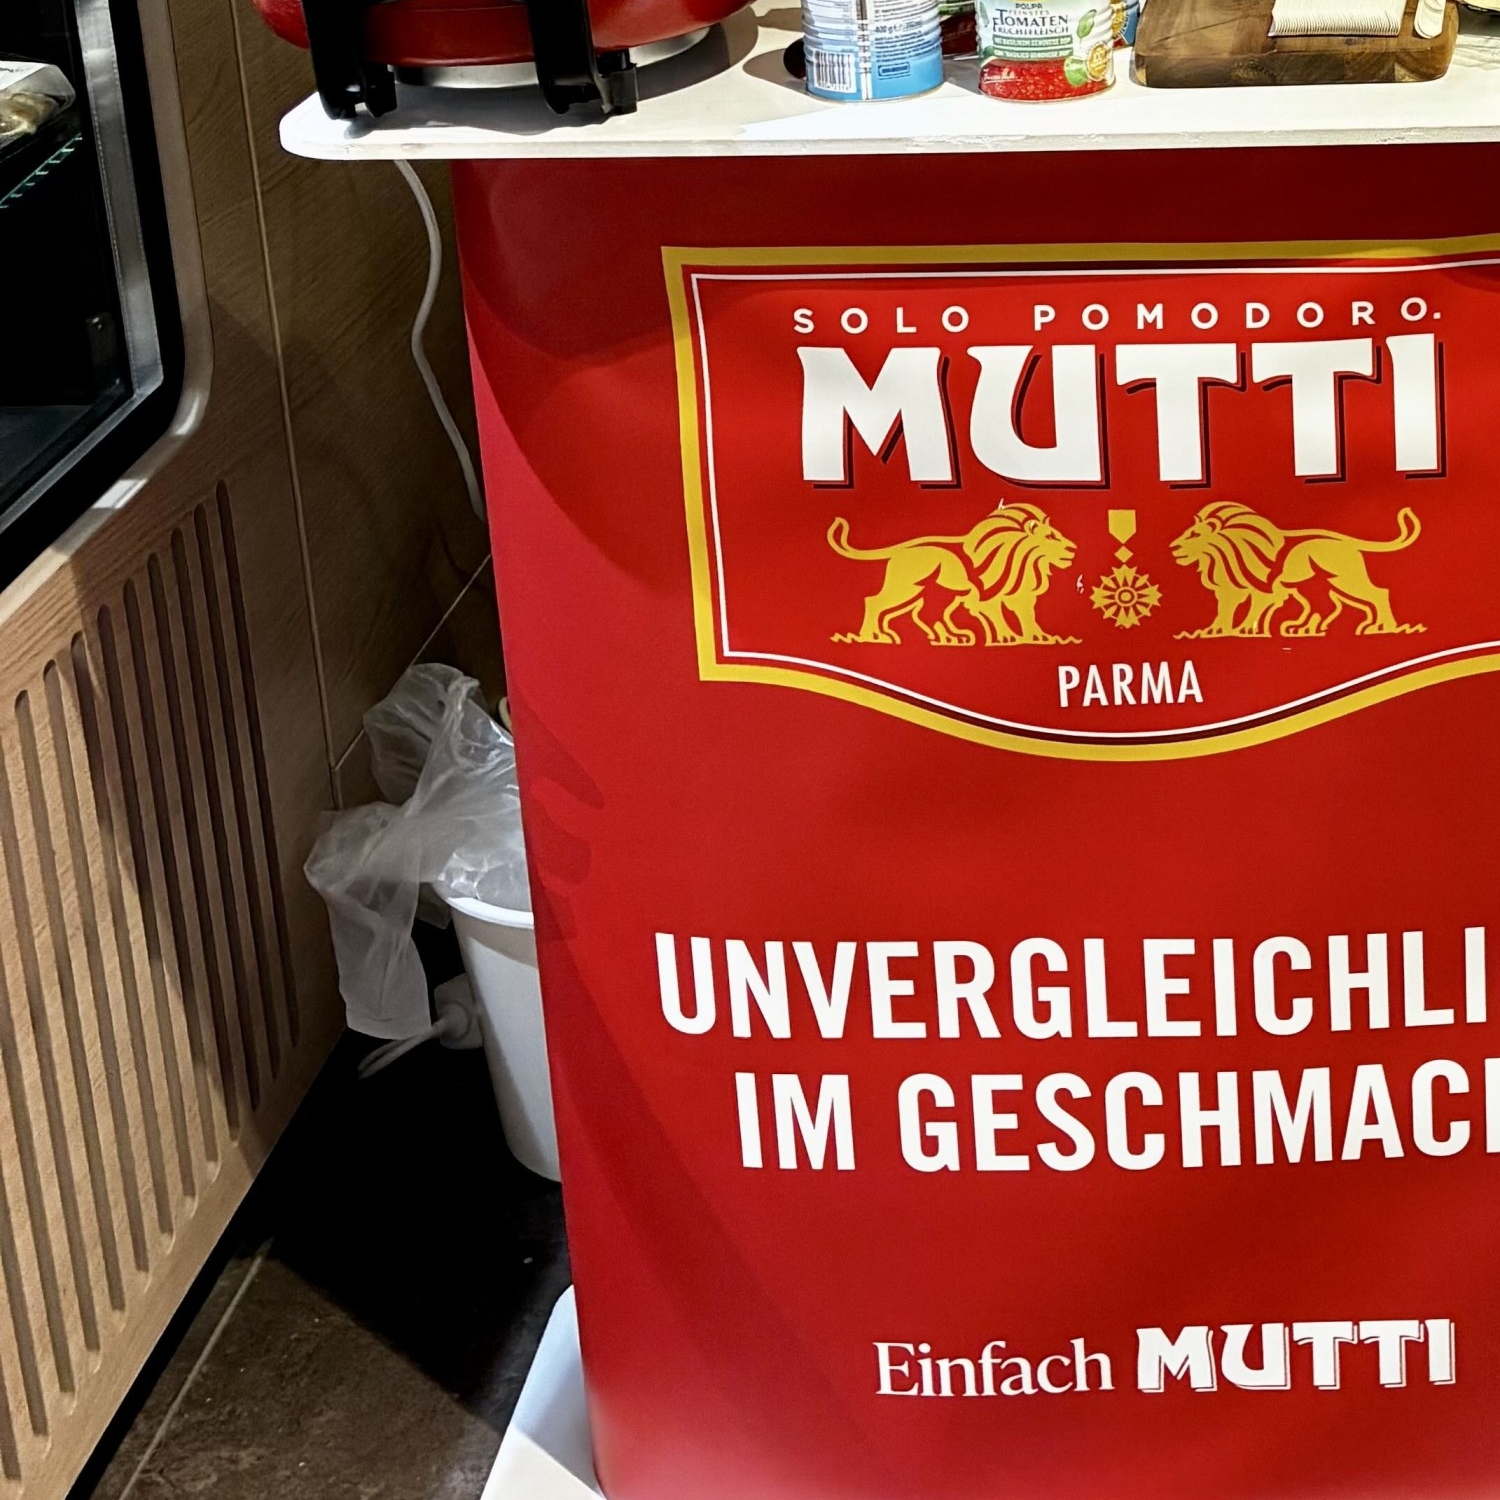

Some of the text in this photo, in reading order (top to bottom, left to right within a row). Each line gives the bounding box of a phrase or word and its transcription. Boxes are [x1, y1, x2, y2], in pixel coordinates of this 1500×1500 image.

[995, 8, 1069, 27] TOMATEN
[793, 296, 1443, 335] SOLO POMODORO.
[796, 333, 1447, 489] MUTTI
[1057, 659, 1204, 708] PARMA
[735, 1070, 857, 1171] IM
[872, 1317, 1457, 1398] Einfach MUTTI
